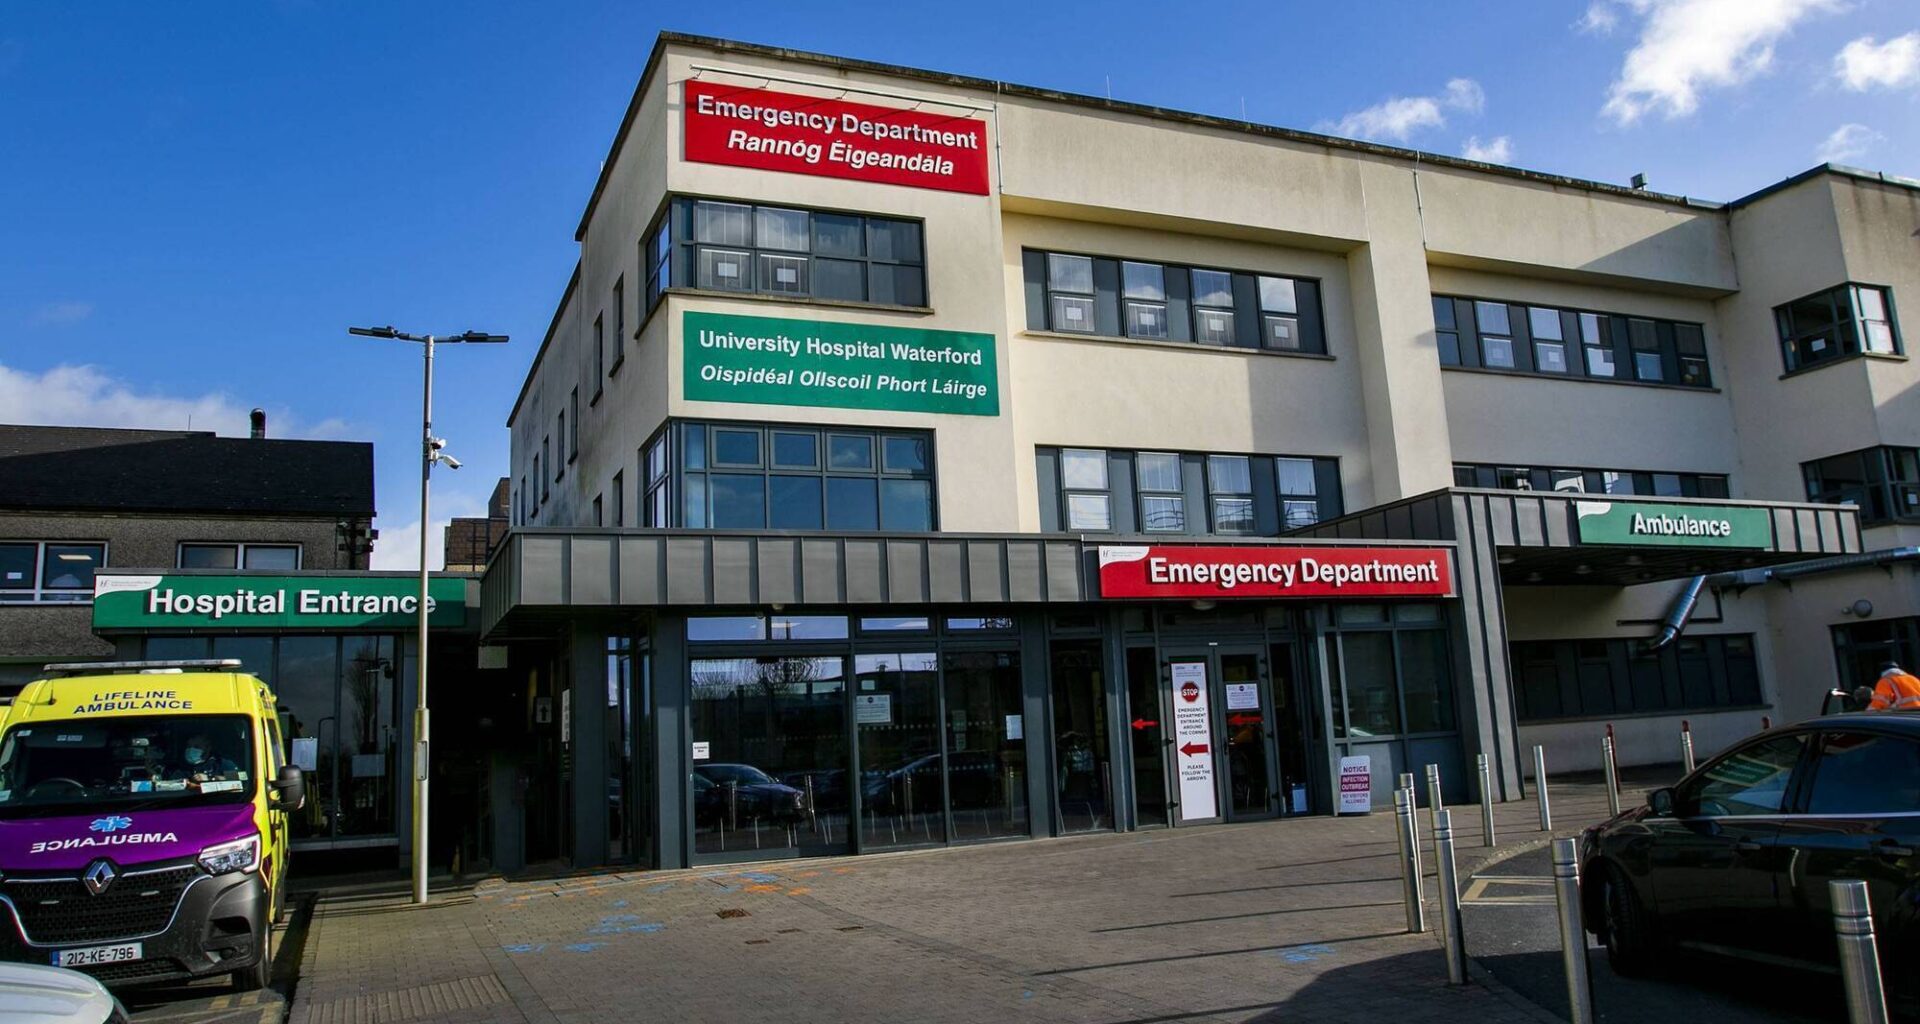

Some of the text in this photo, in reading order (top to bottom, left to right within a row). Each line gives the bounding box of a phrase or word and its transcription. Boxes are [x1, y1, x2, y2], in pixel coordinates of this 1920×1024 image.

[697, 94, 978, 149] Emergency Department
[728, 129, 954, 176] Rannóg Éigeandála
[699, 329, 982, 366] University Hospital Waterford
[700, 364, 988, 400] Oispidéal Ollscoil Phort Láirge
[1634, 512, 1731, 536] Ambulance
[1150, 557, 1439, 587] Emergency Department
[150, 589, 285, 618] Hospital
[73, 700, 193, 714] AMBULANCE
[94, 690, 177, 702] LIFELINE
[1182, 688, 1198, 697] STOP
[67, 947, 134, 965] 212-KE-796
